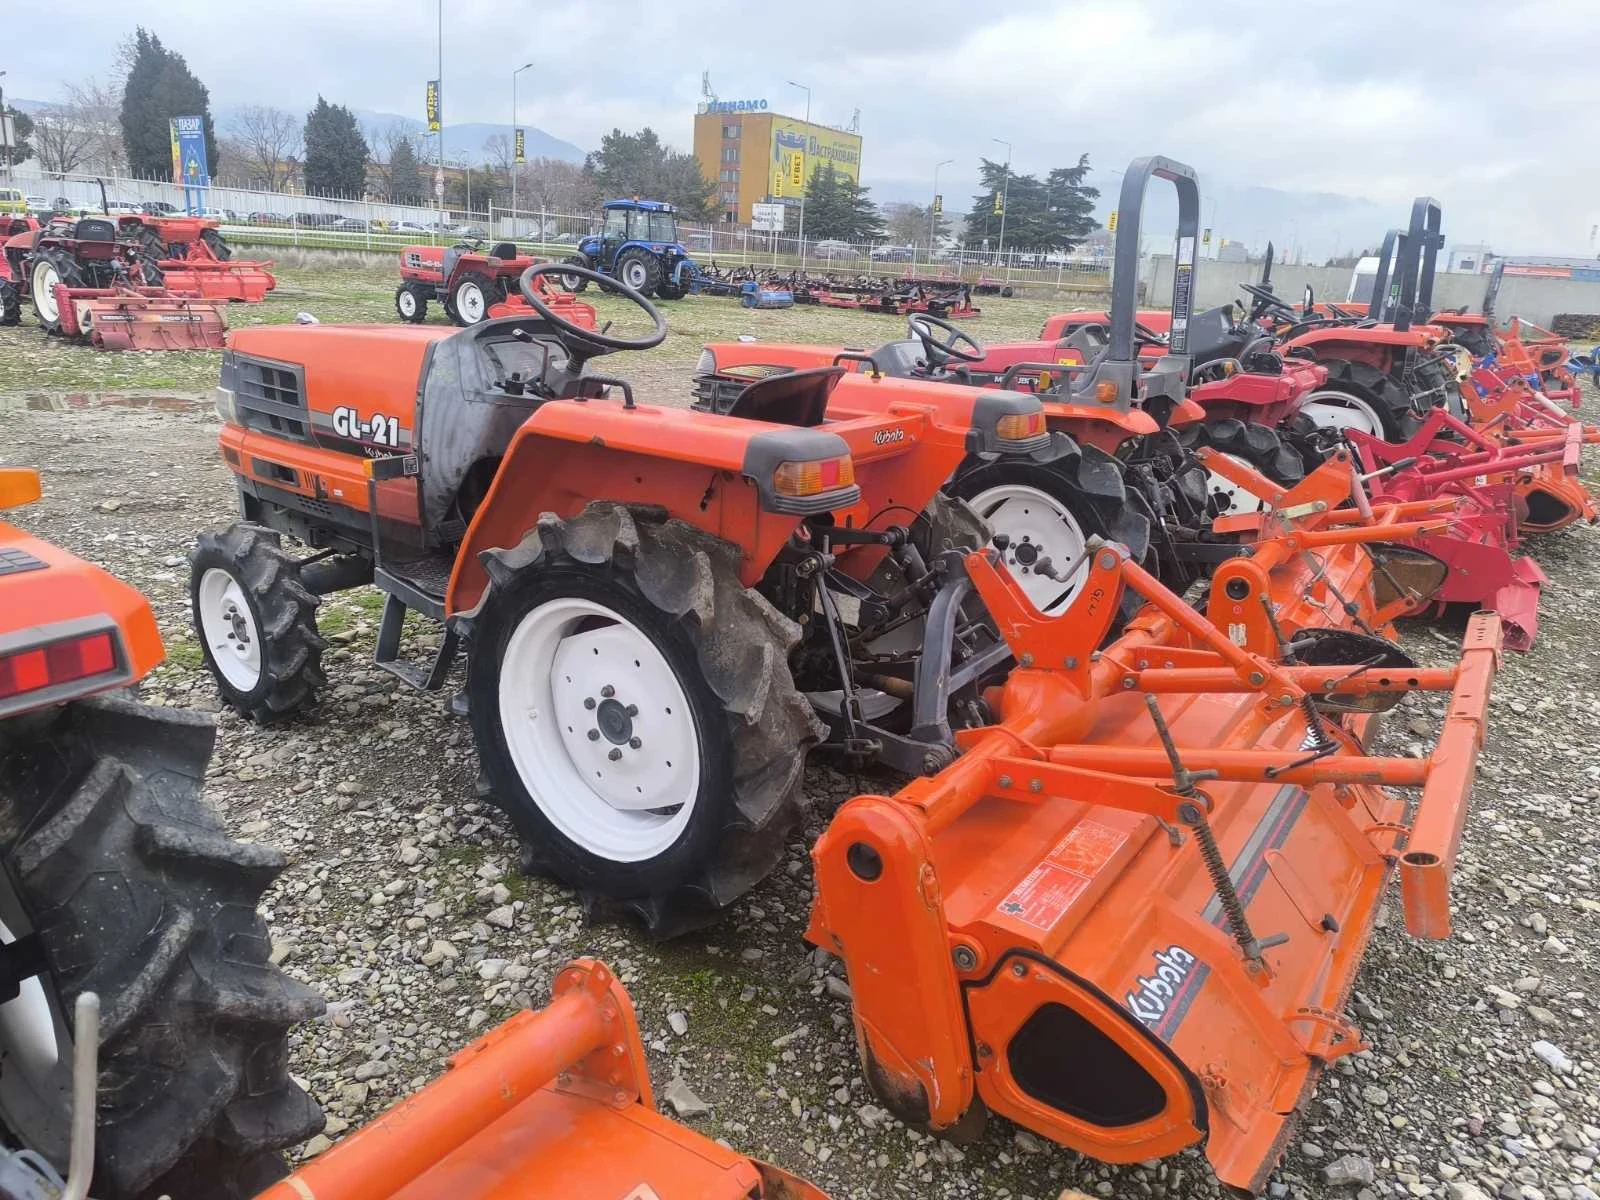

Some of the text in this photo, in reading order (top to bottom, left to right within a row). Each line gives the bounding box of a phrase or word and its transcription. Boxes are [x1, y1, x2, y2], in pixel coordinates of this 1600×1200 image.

[332, 405, 399, 448] GL-21
[873, 428, 904, 445] Kubota
[1127, 945, 1196, 1020] Kubota
